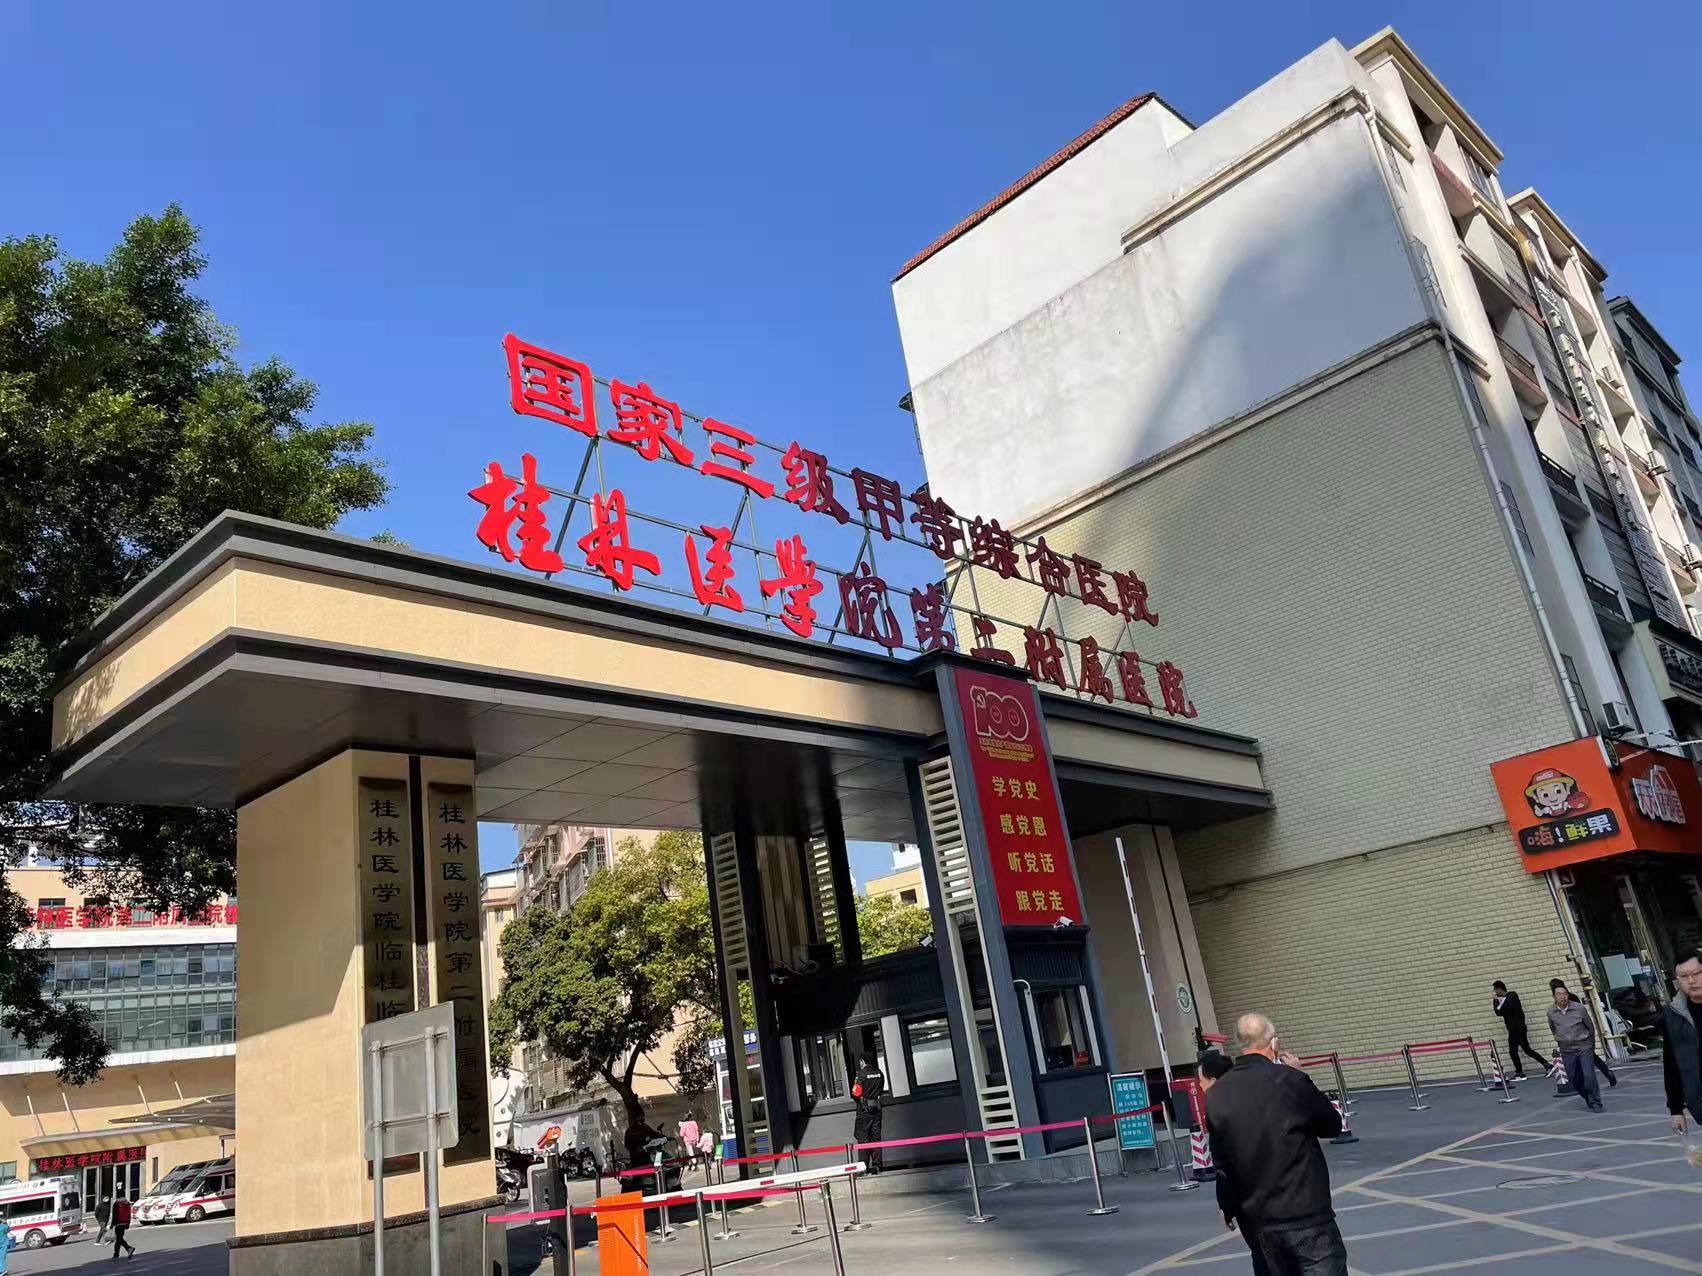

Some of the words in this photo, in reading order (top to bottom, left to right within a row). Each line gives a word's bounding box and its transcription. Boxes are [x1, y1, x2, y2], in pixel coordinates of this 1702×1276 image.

[502, 332, 1159, 627] 国家三级甲等综合医院
[468, 453, 1198, 718] 桂林医学院第二附属医院
[991, 776, 1040, 801] 学党史
[1000, 814, 1047, 837] 感党恩
[1007, 851, 1055, 874] 听党话
[1015, 889, 1065, 913] 跟党走
